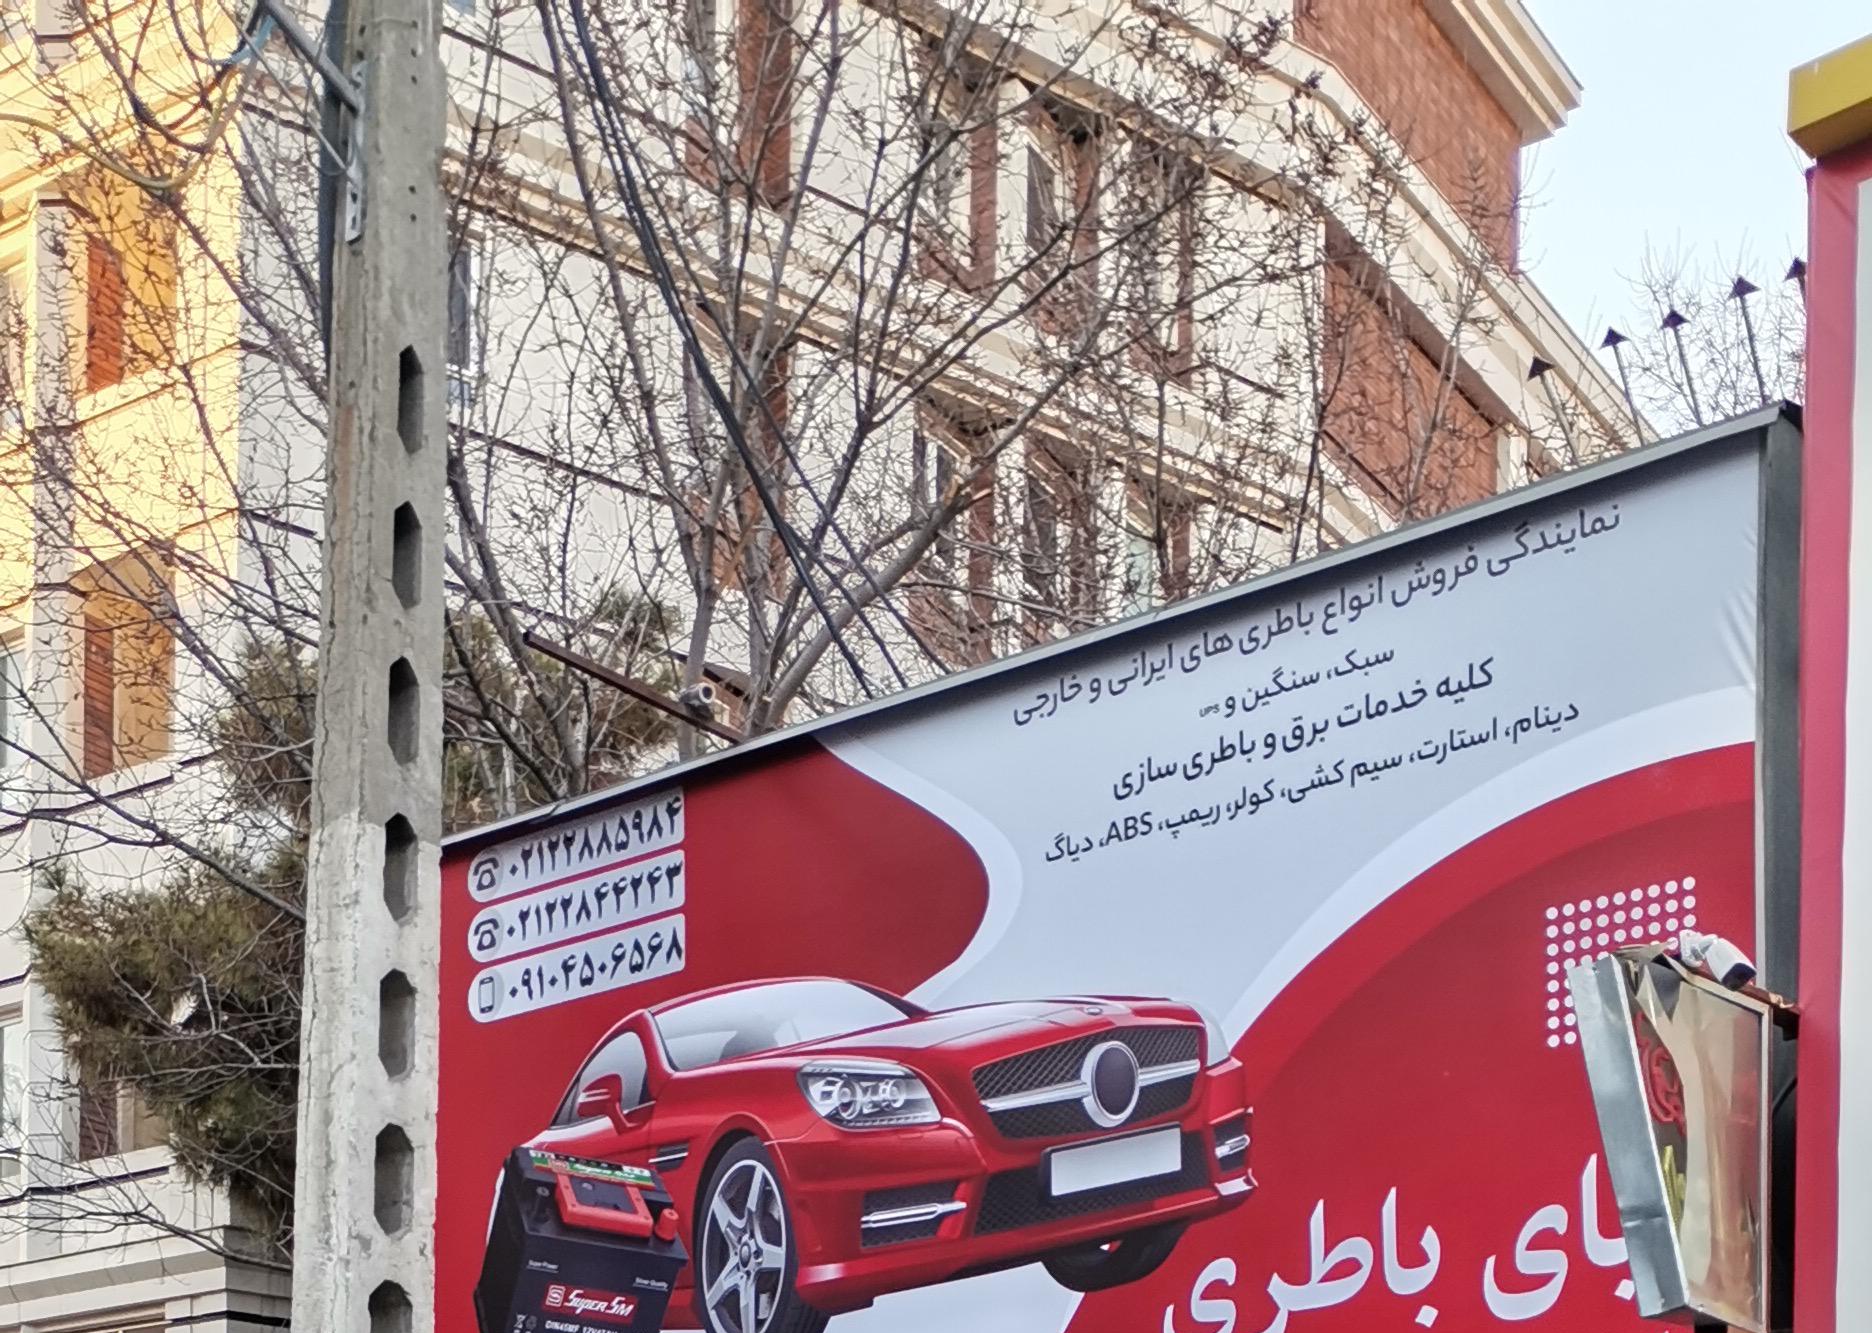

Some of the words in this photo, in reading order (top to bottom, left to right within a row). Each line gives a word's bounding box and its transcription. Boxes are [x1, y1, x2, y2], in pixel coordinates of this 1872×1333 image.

[1487, 505, 1619, 577] نمایندگی
[1391, 545, 1479, 608] فروش
[1239, 602, 1314, 655] باطری
[1322, 575, 1384, 635] انواع
[1108, 643, 1172, 696] ایرانی
[1181, 632, 1233, 673] های
[1327, 649, 1394, 680] سبک،
[1014, 675, 1082, 726] خارجی
[1089, 678, 1101, 703] و
[1242, 666, 1320, 712] سنگین
[1436, 656, 1494, 704] کلیه
[1224, 696, 1237, 718] و
[1337, 680, 1428, 728] خدمات
[1505, 703, 1580, 744] دینام،
[1183, 730, 1257, 781] باطری
[1263, 733, 1276, 759] و
[1282, 716, 1329, 753] برق
[1409, 717, 1497, 764] استارت،
[1113, 757, 1177, 800] سازی
[1281, 759, 1344, 804] کشی،
[1351, 755, 1402, 788] سیم
[509, 796, 683, 880] ۰۲۱۲۲۸۸۵۹۸۴
[1046, 832, 1093, 862] دیاگ
[509, 927, 684, 1001] ۰۹۱۰۴۵۰۶۵۶۸
[1484, 1153, 1635, 1321] بای
